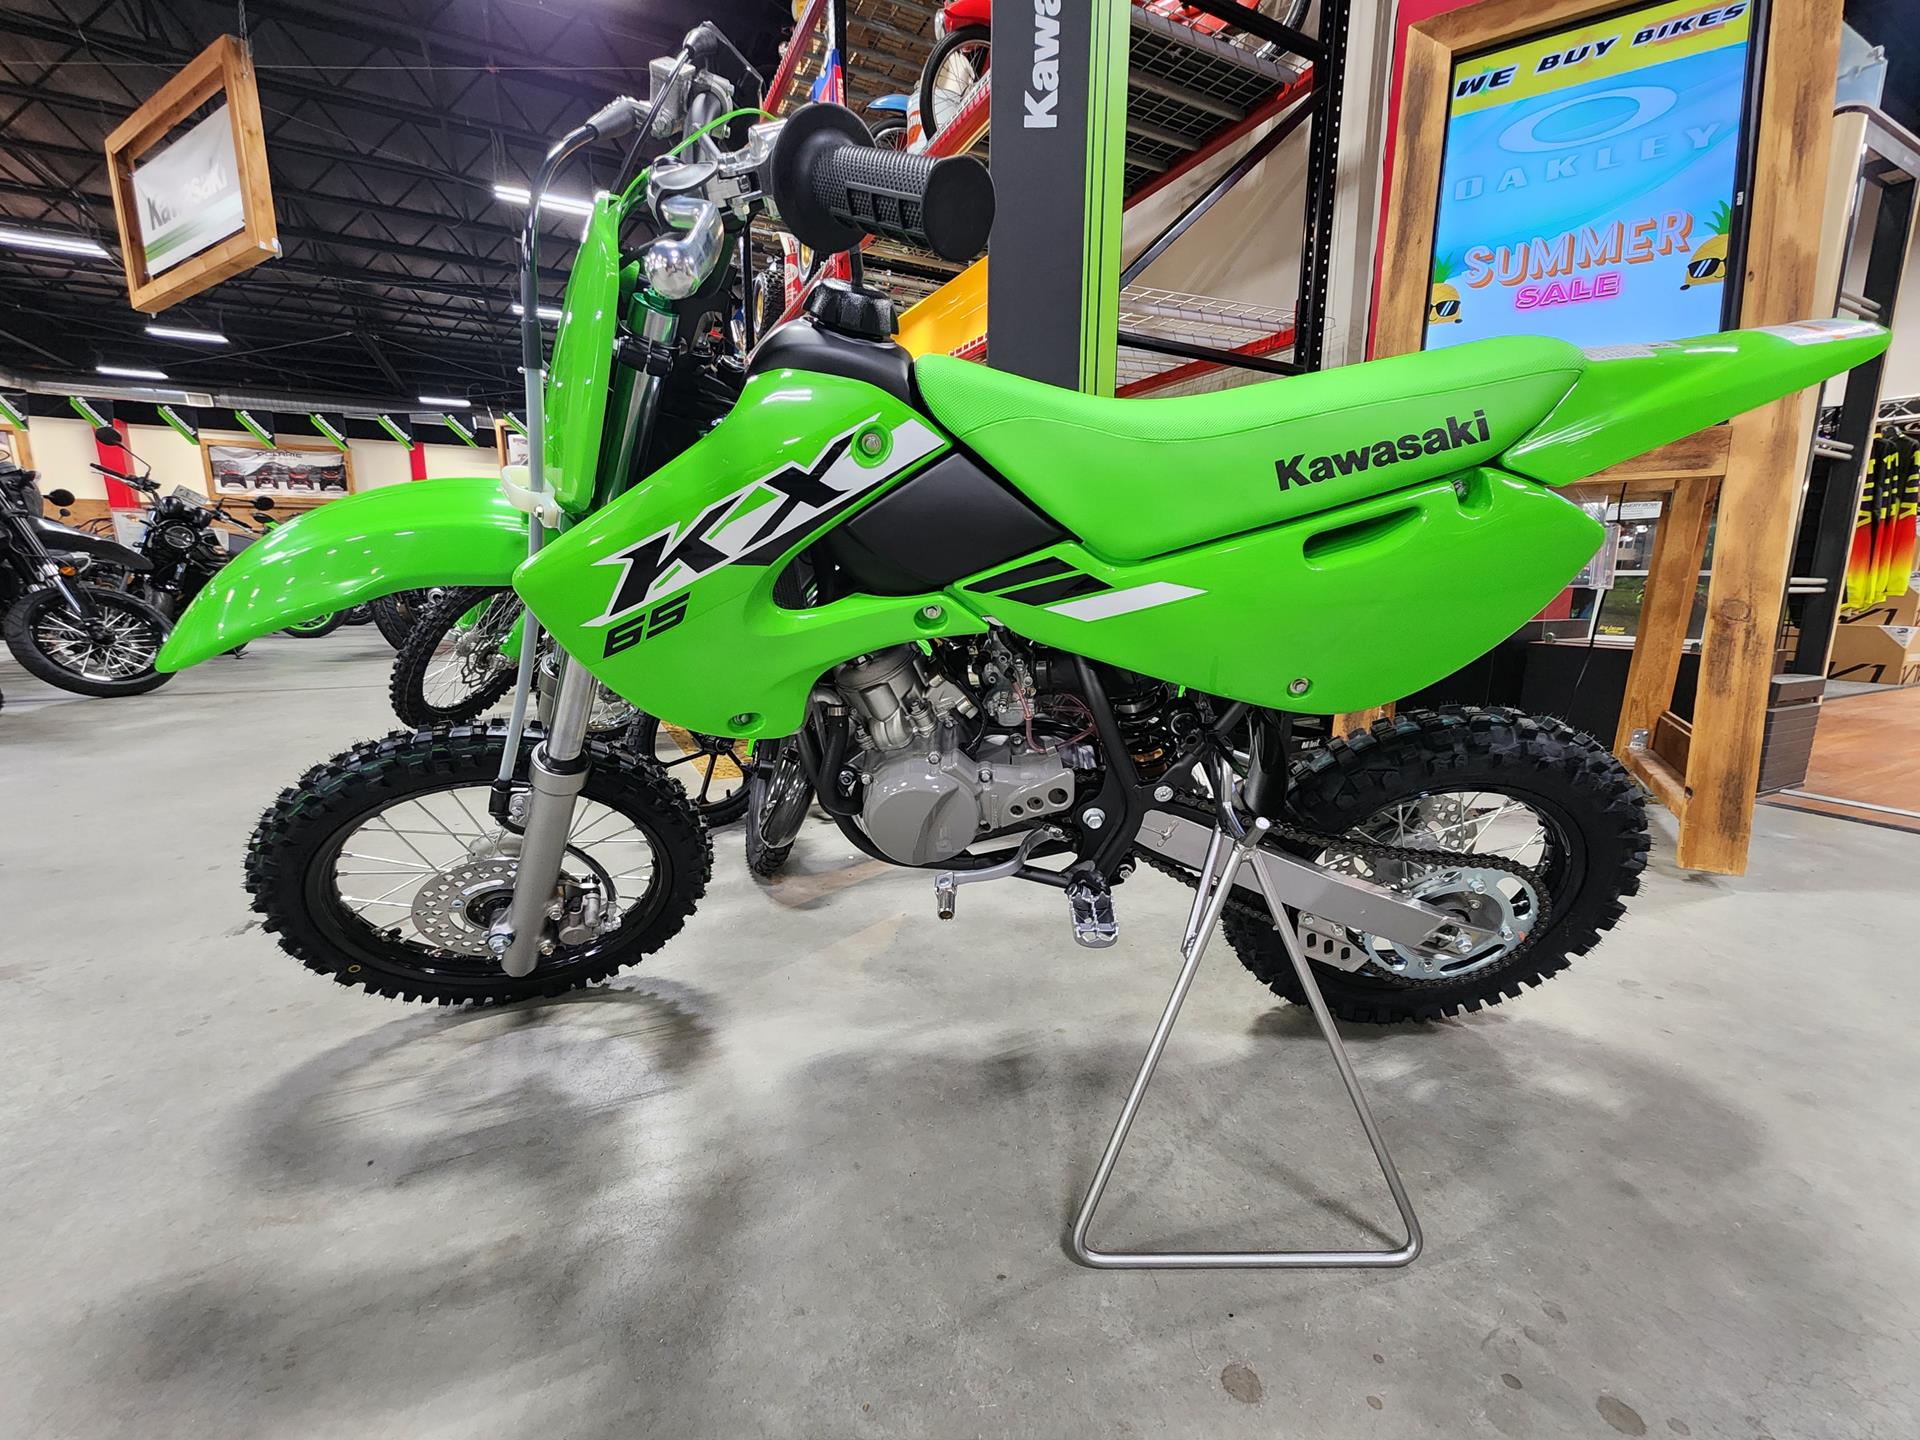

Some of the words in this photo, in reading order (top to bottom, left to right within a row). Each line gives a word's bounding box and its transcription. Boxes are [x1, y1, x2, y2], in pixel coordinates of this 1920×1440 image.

[1455, 66, 1517, 98] WE
[1536, 38, 1617, 73] BUY
[1633, 2, 1748, 46] BIKES
[1454, 123, 1721, 200] OAKLEY
[1464, 208, 1695, 289] SUMMER
[1515, 272, 1622, 308] SALE
[1274, 409, 1491, 492] Kawasaki
[606, 431, 858, 618] KX
[602, 591, 692, 660] 65
[1827, 661, 1888, 684] V1
